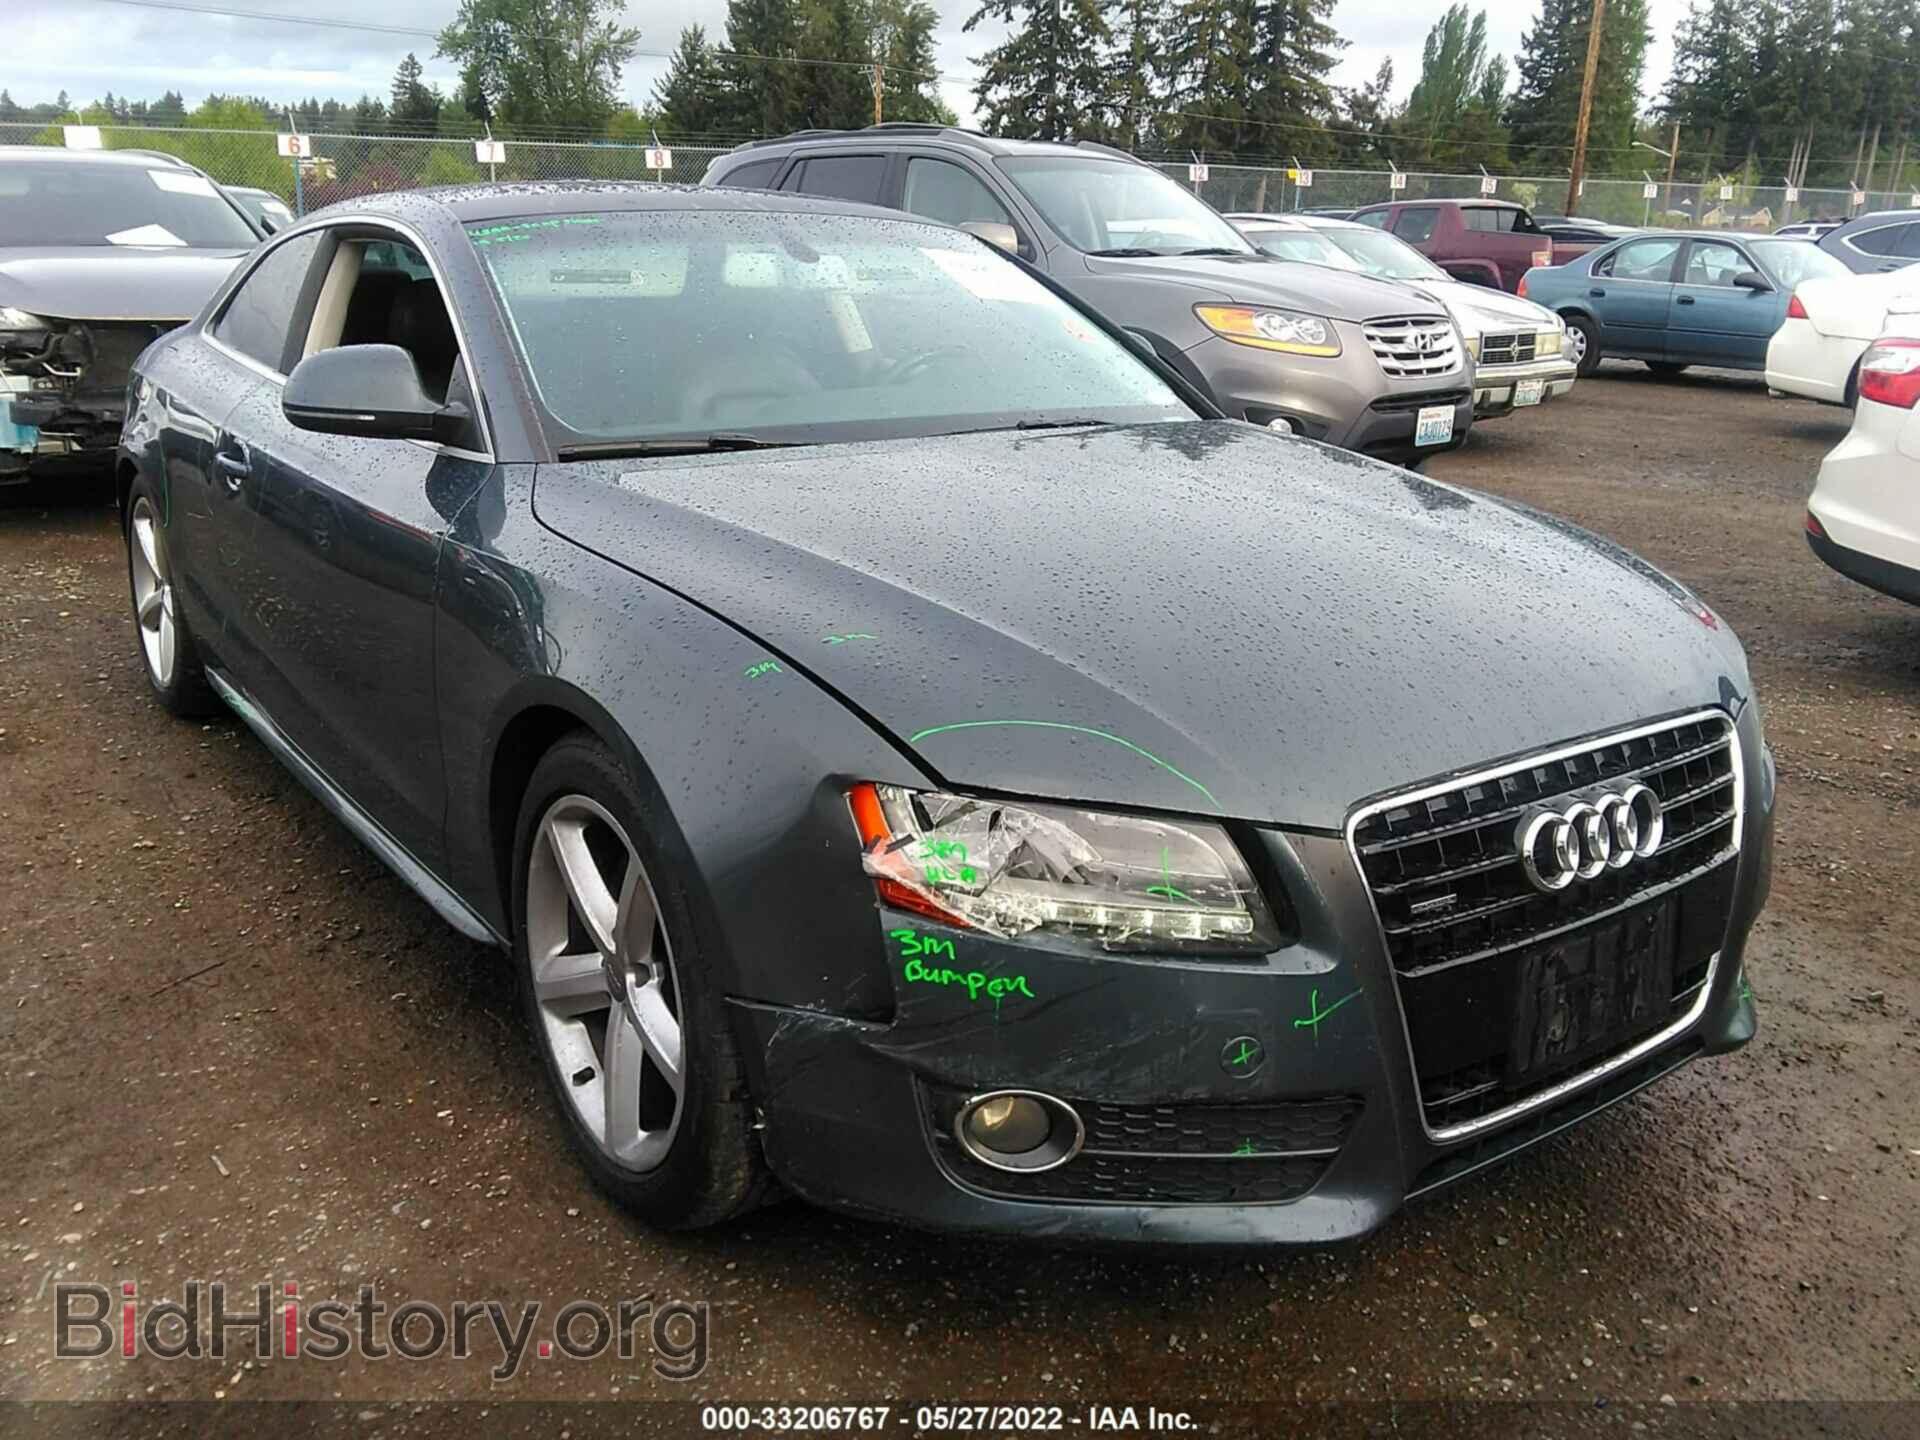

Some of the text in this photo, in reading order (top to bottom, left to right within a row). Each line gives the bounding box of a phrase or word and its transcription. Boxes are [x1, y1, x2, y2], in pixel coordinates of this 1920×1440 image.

[288, 136, 301, 155] 6
[486, 143, 495, 161] 7
[654, 150, 664, 167] 8
[1193, 165, 1205, 180] 12
[1299, 170, 1310, 185] 13
[1394, 175, 1403, 187] 14
[1485, 178, 1494, 192] 15
